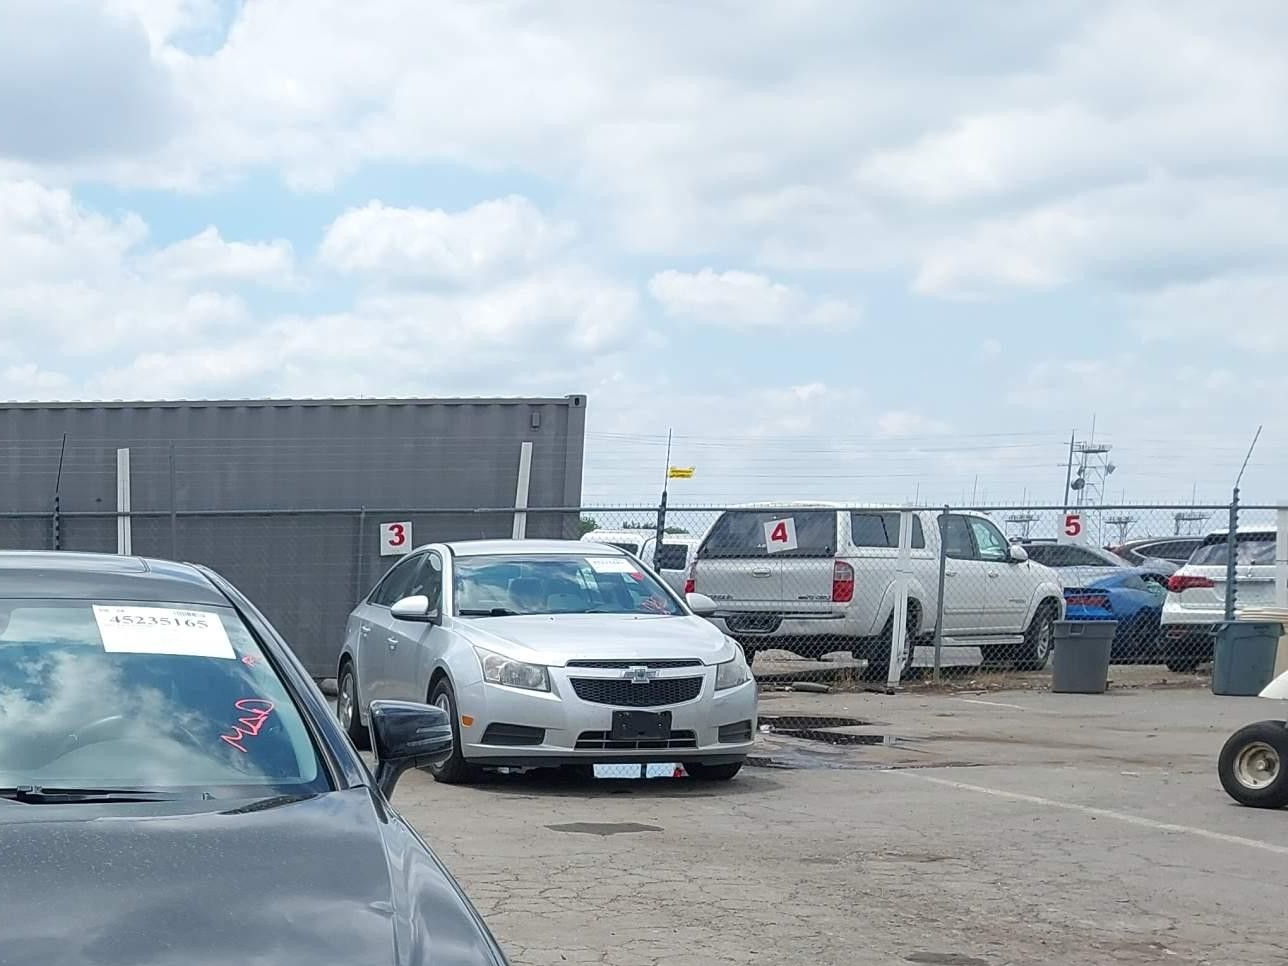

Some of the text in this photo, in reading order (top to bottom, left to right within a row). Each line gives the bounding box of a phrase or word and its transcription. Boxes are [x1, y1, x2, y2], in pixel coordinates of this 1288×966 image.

[388, 524, 405, 546] 3
[771, 522, 788, 543] 4
[1064, 515, 1081, 536] 5
[110, 615, 209, 629] 45235165
